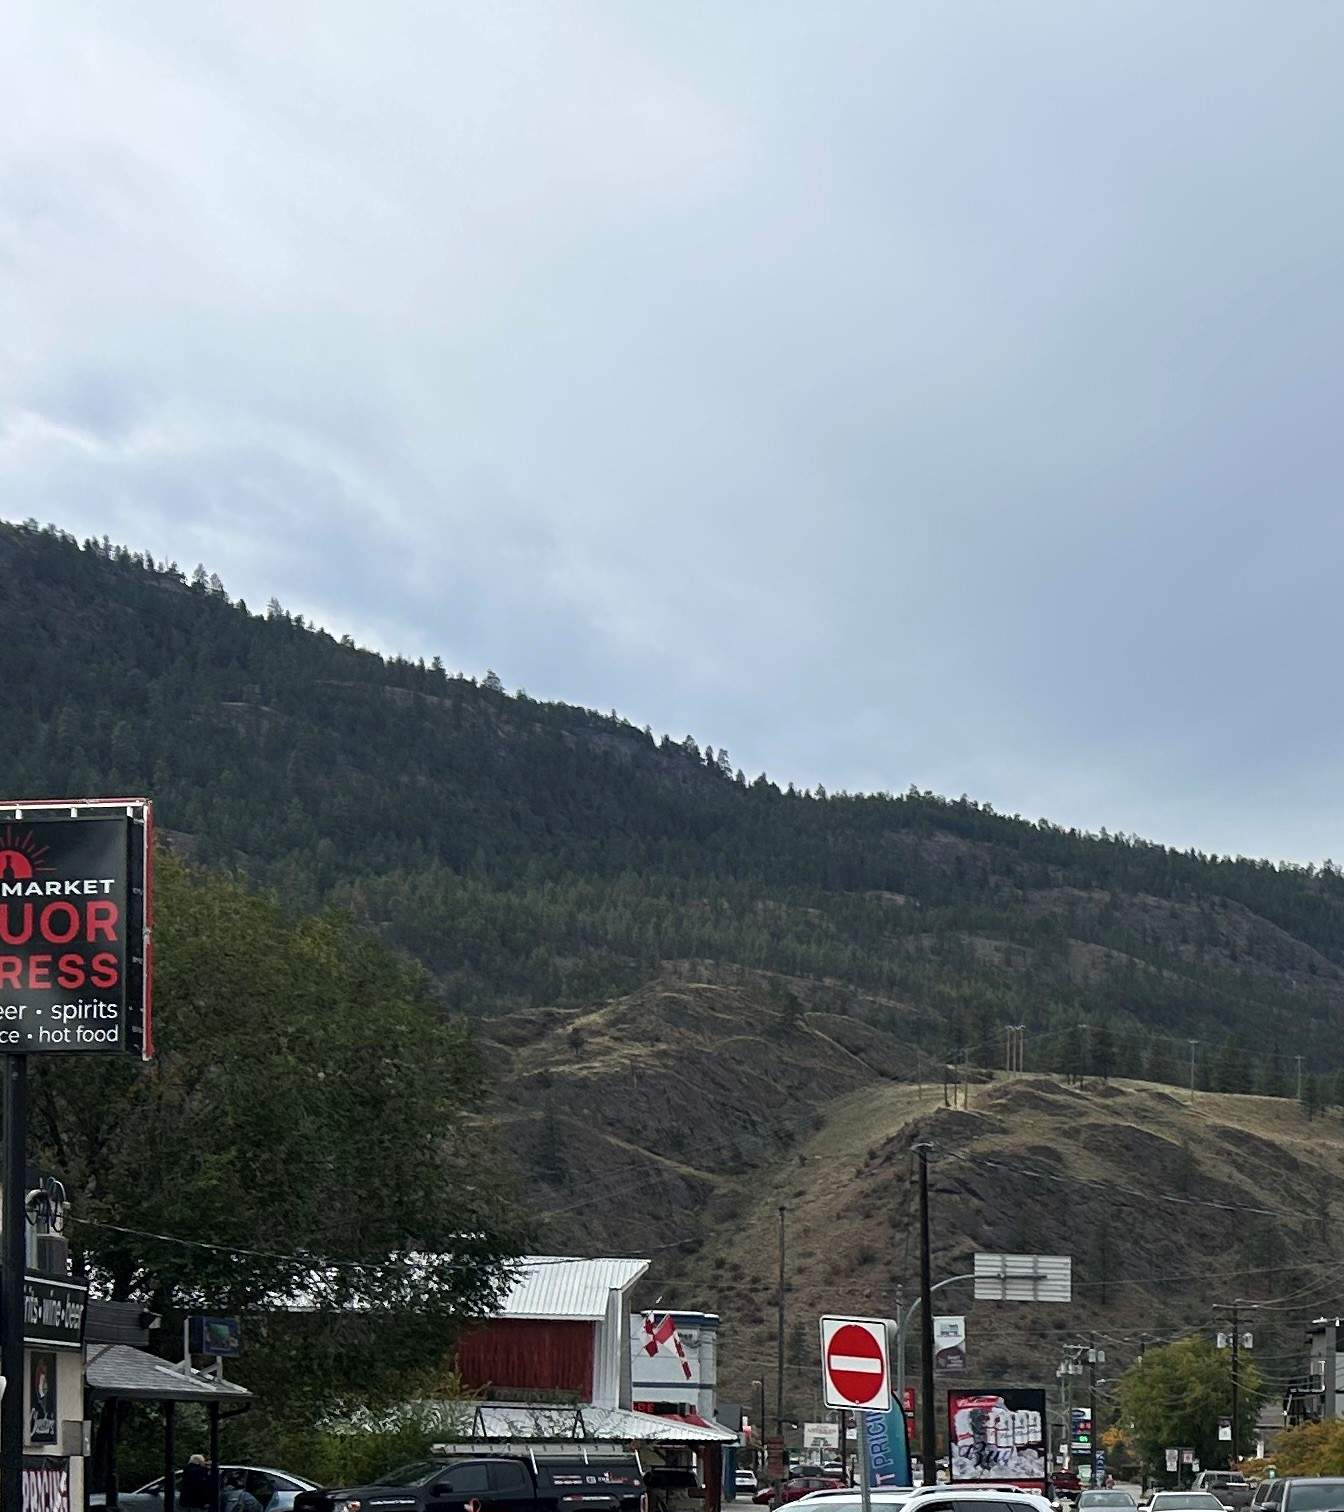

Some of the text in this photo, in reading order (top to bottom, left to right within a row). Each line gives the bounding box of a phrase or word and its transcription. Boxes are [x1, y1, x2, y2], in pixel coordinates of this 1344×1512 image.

[1, 879, 115, 897] MARKET
[0, 901, 119, 945] UOR
[0, 953, 118, 990] RESS
[51, 999, 118, 1023] spirits
[38, 1026, 72, 1043] hot
[76, 1024, 119, 1043] food
